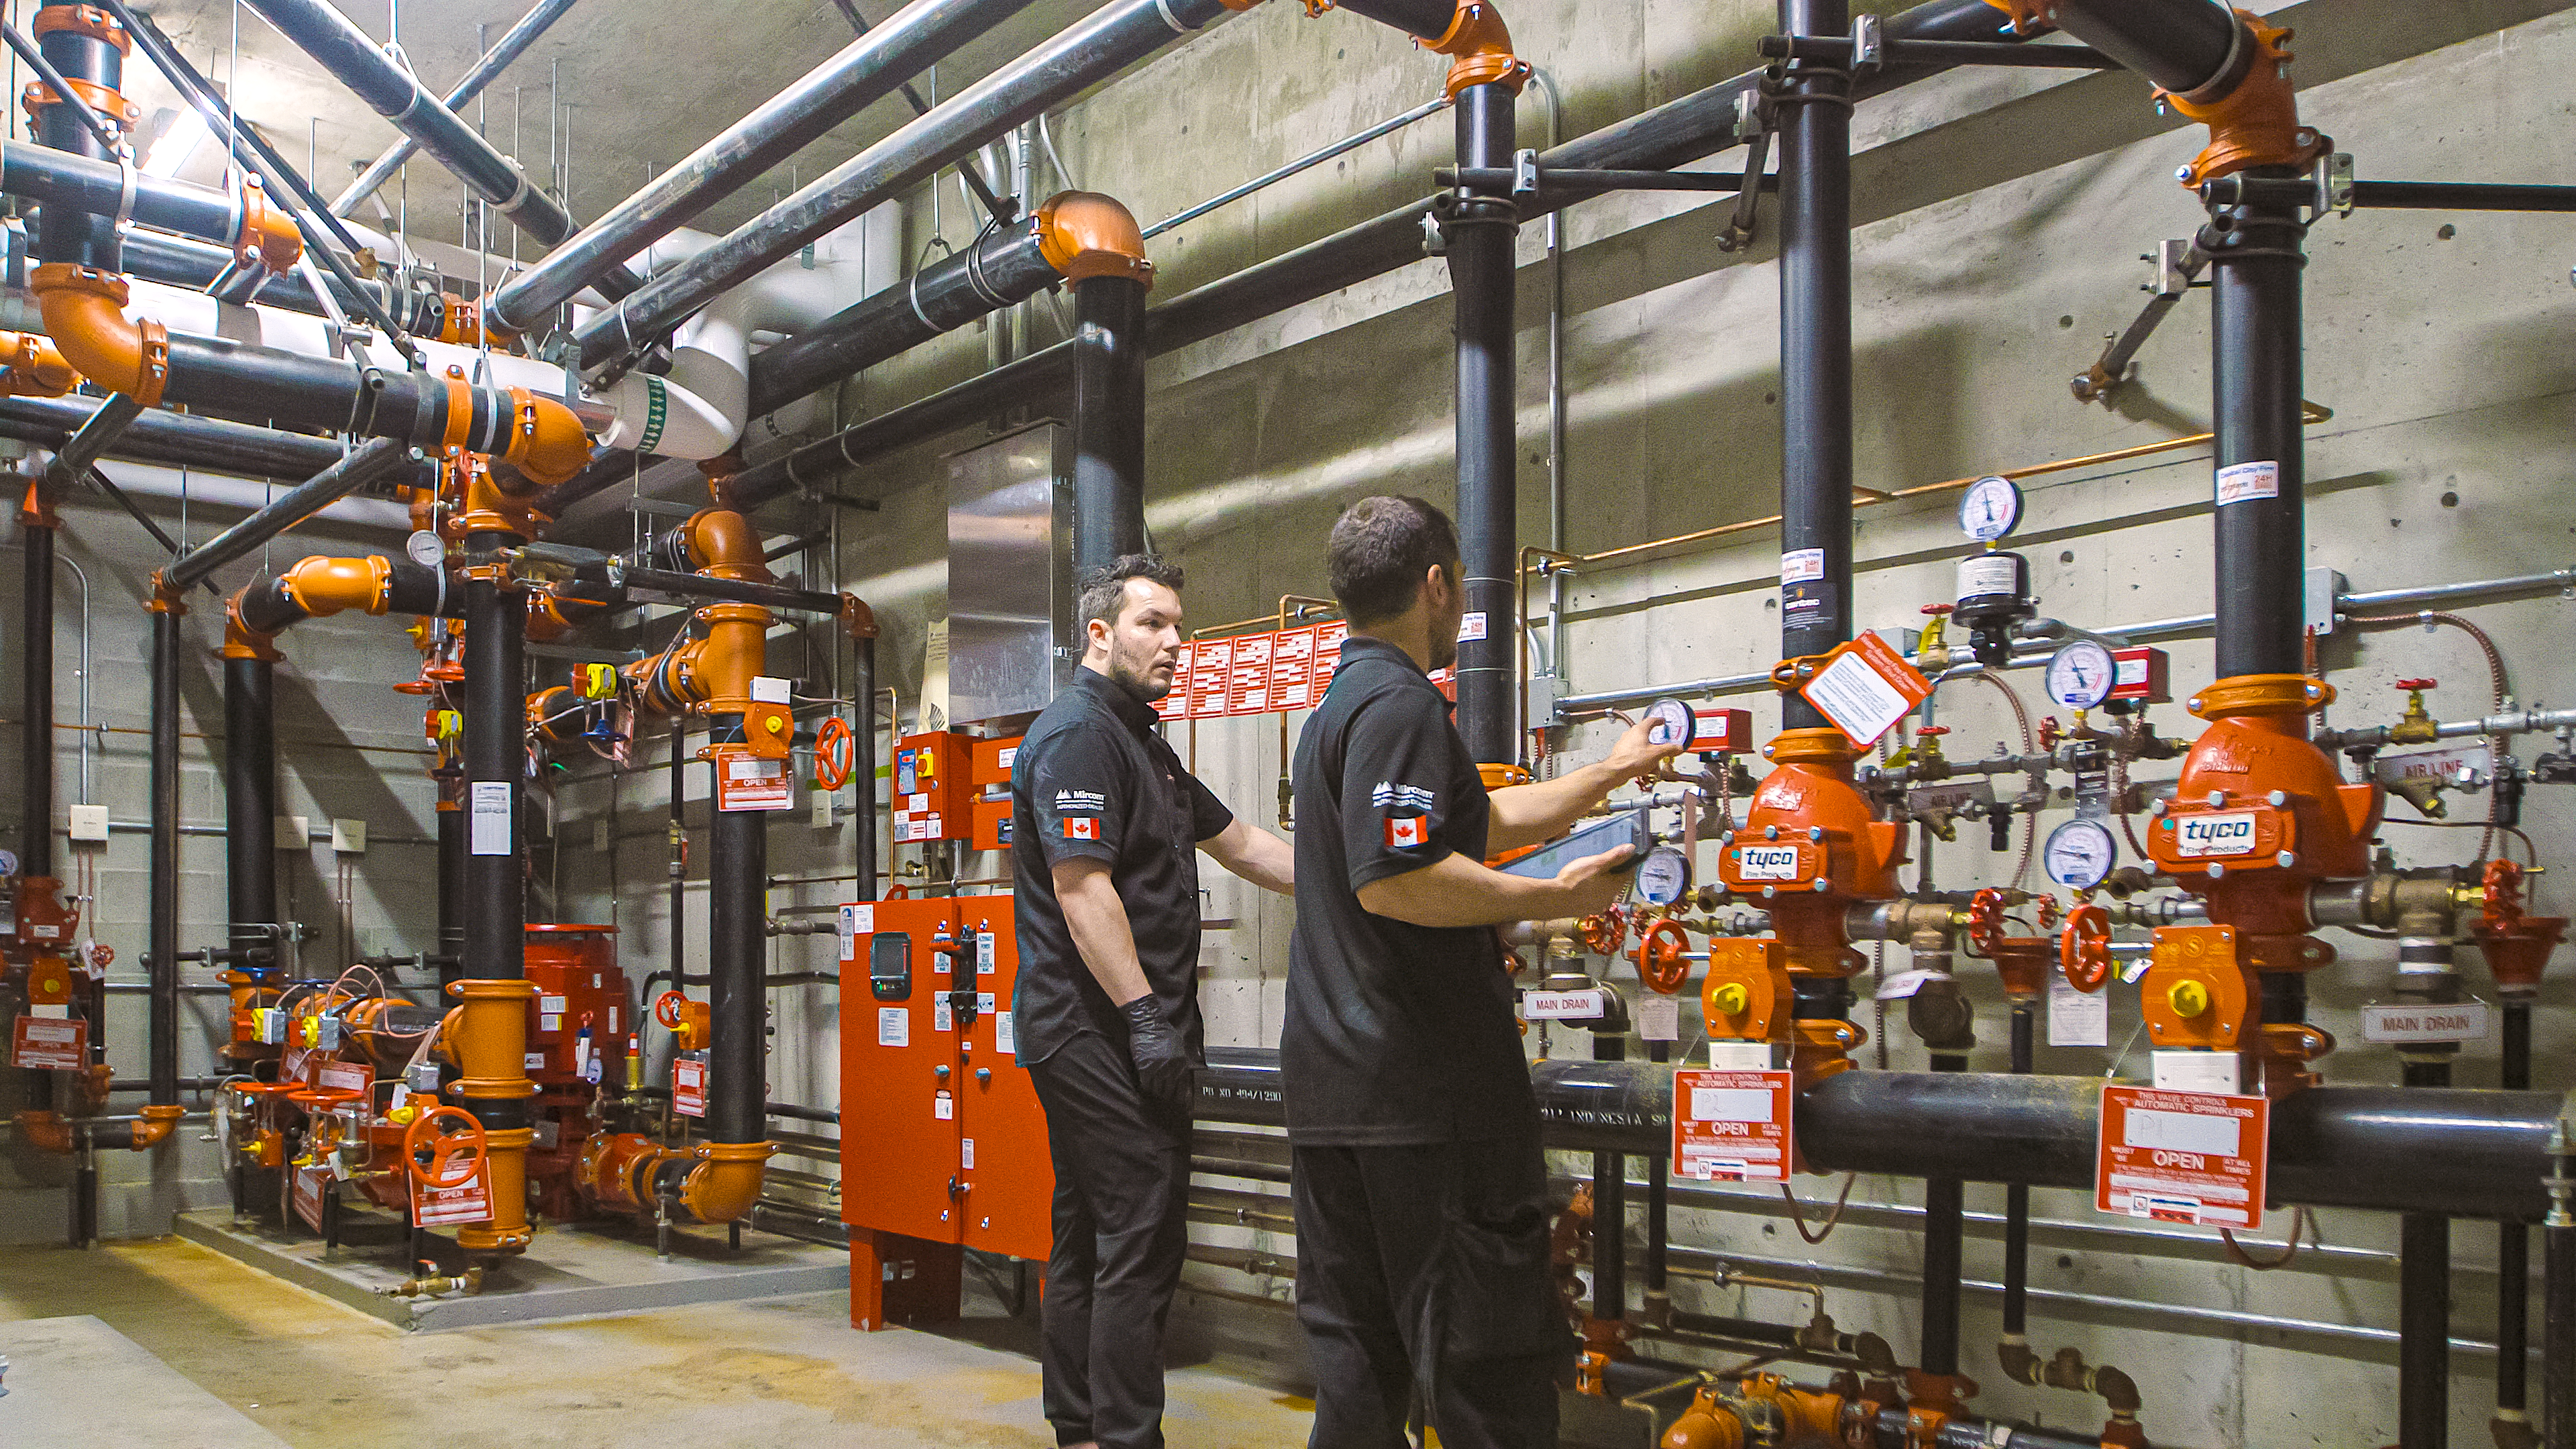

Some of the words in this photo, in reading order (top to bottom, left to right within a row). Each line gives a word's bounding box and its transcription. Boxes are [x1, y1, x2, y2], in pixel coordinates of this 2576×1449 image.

[743, 778, 767, 787] OPEN
[1073, 790, 1104, 801] Mircom
[2186, 821, 2250, 843] tyco
[1746, 849, 1792, 869] tyco
[1536, 1000, 1558, 1010] MAIN
[1562, 998, 1589, 1010] DRAIN
[2383, 1018, 2419, 1031] MAIN
[2426, 1015, 2470, 1031] DRAIN
[2133, 1099, 2191, 1112] AUTOMATIC
[2193, 1106, 2255, 1118] SPRINKLERS
[1711, 1122, 1750, 1136] OPEN
[2151, 1149, 2205, 1171] OPEN
